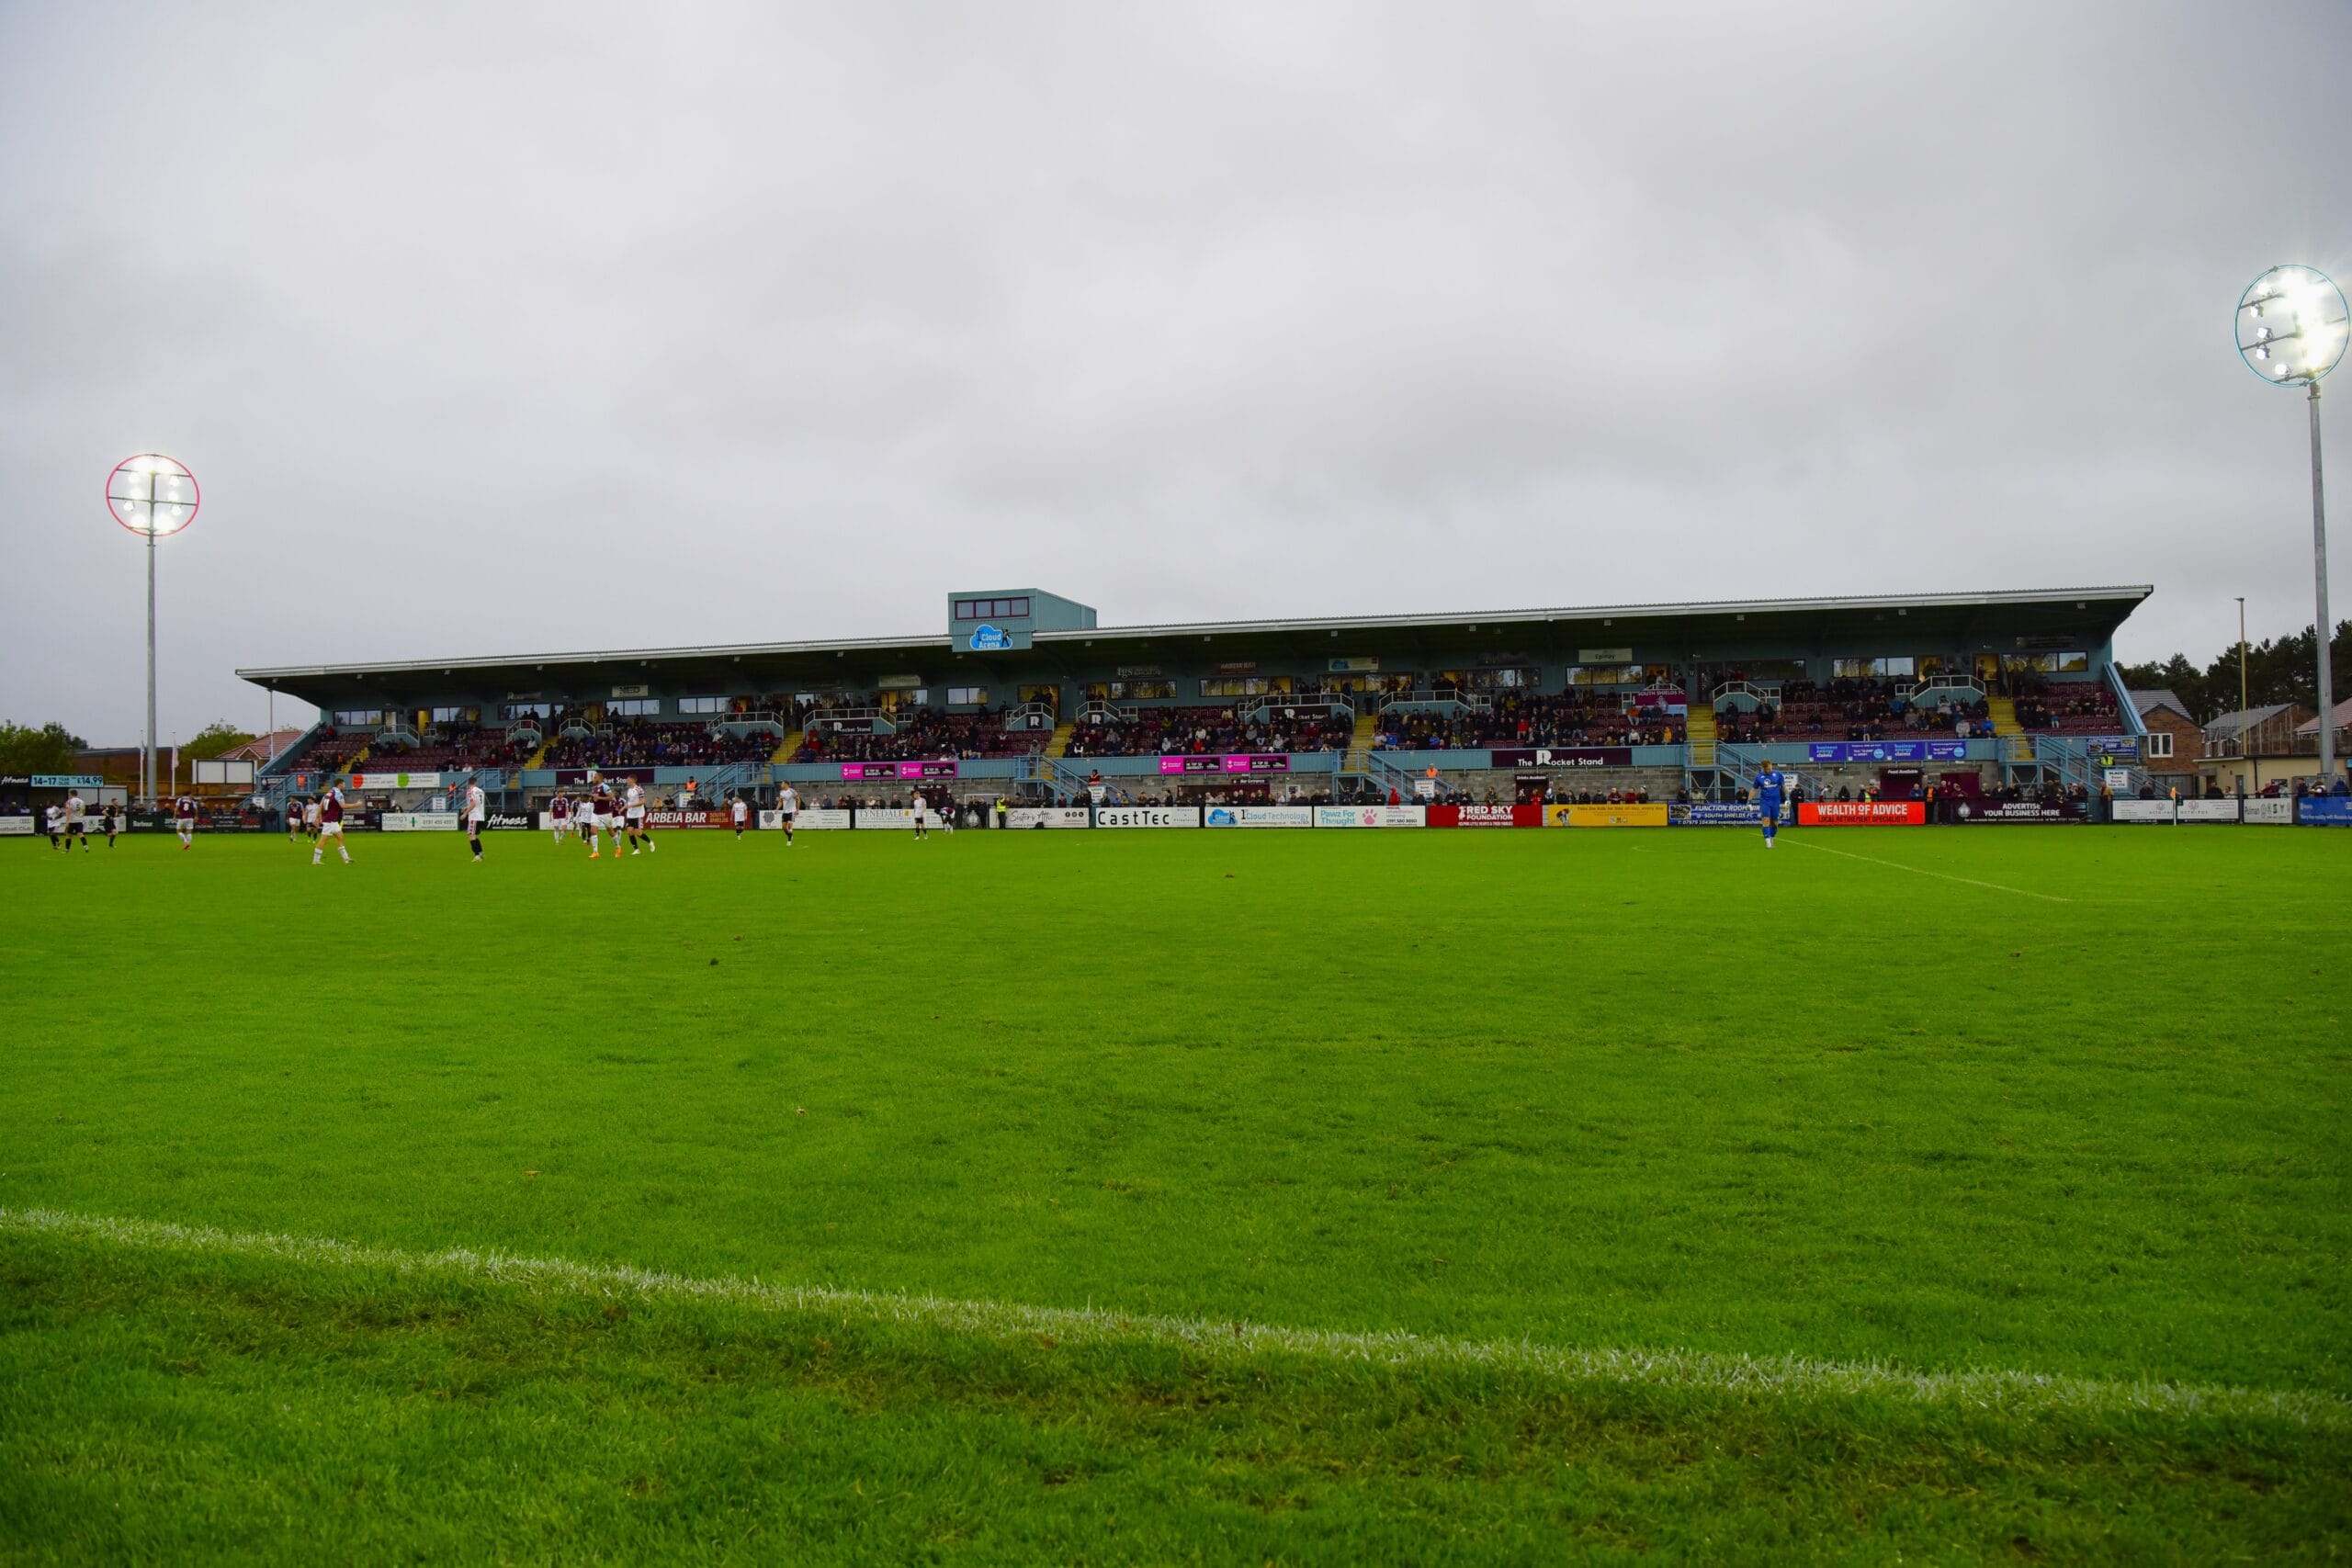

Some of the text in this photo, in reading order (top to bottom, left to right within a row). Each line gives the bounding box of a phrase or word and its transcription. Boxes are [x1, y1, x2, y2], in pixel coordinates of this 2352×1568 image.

[981, 632, 1001, 641] Cloud
[1518, 750, 1603, 767] The Rocket Stand
[184, 803, 189, 811] 8
[1466, 806, 1513, 814] RED SKY
[1817, 804, 1907, 815] WEALTH OF ADVICE
[645, 812, 707, 823] ARBEIA BAR
[859, 809, 903, 818] TYNEDALE
[1247, 812, 1267, 820] Cloud
[1268, 812, 1308, 822] Technology
[486, 814, 527, 829] fitness
[1321, 818, 1356, 826] Thought
